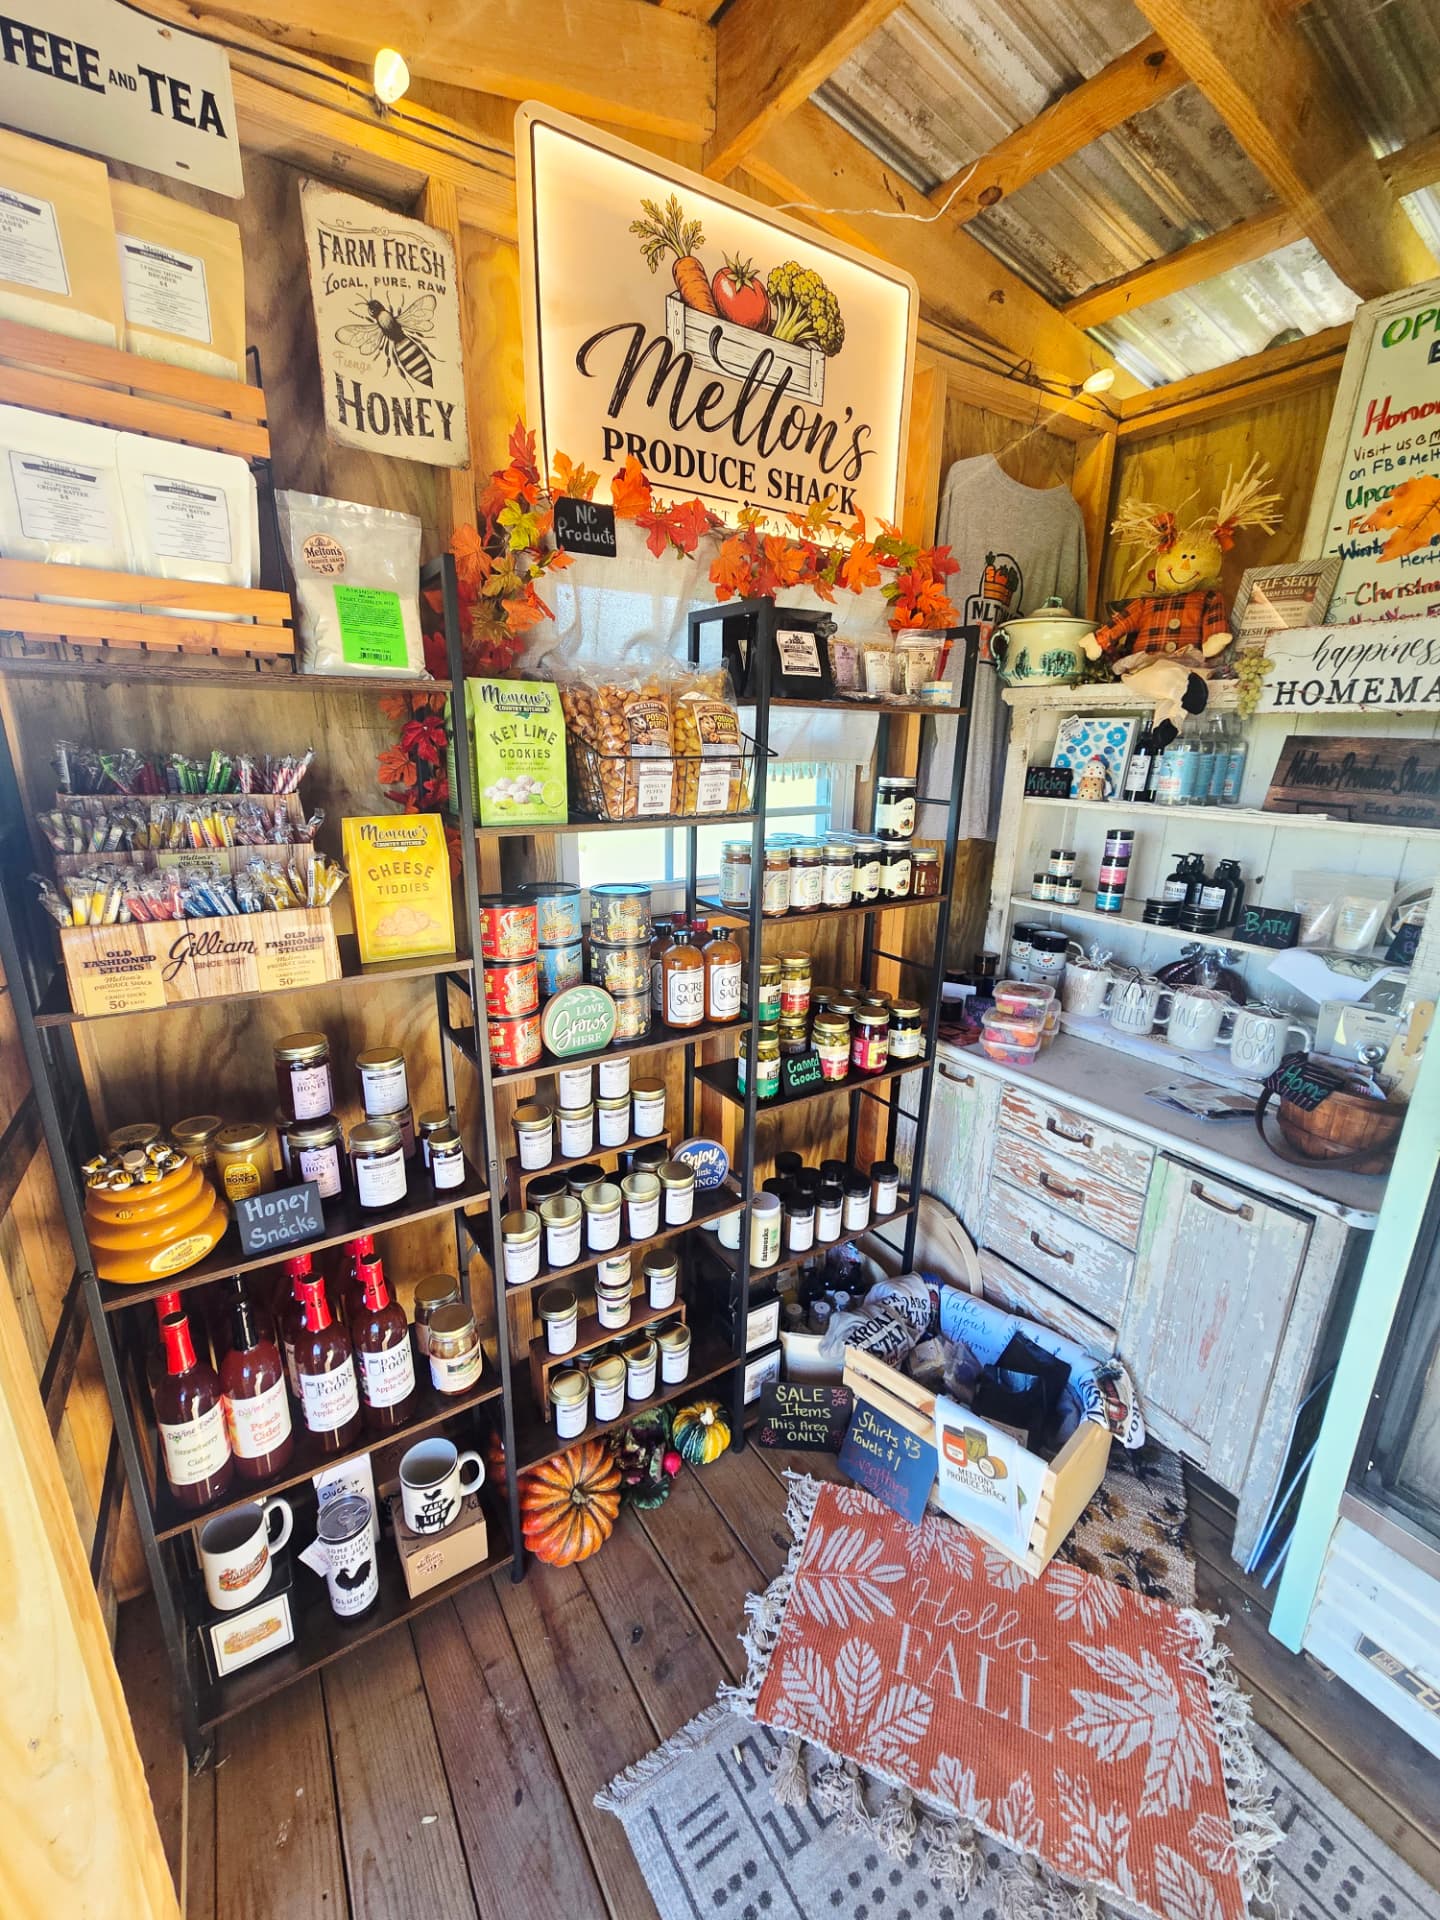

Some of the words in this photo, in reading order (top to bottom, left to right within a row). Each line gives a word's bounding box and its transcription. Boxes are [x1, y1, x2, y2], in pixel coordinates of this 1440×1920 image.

[108, 69, 137, 92] AND
[137, 63, 228, 139] TEA
[318, 228, 377, 270] FARM
[383, 238, 446, 281] FRESH
[417, 280, 447, 295] RAW
[334, 371, 456, 441] HONEY
[575, 322, 878, 483] Melton's
[1354, 446, 1391, 462] Visit
[1397, 438, 1411, 451] us
[602, 427, 757, 493] PRODUCE
[767, 468, 858, 517] SHACK
[1350, 468, 1366, 481] on
[1373, 459, 1394, 474] FB
[576, 505, 597, 525] NC
[558, 516, 615, 546] Products
[303, 546, 342, 558] Melton's
[489, 724, 518, 746] KEY
[524, 723, 558, 746] LIME
[499, 748, 551, 759] COOKIES
[1028, 776, 1067, 790] Kitchen
[368, 862, 434, 881] CHEESE
[377, 882, 430, 895] TIDDIES
[1245, 911, 1291, 935] BATH
[265, 936, 325, 949] FASHIONED
[284, 931, 306, 940] OLD
[83, 955, 157, 968] FASHIONED
[106, 950, 132, 958] OLD
[162, 930, 257, 981] Gilliam
[100, 963, 145, 975] STICKS
[109, 999, 127, 1010] 50
[576, 1003, 605, 1018] LOVE
[552, 1010, 614, 1050] Grows
[572, 1033, 603, 1048] HERE
[296, 1081, 326, 1093] HONEY
[789, 1068, 822, 1087] Goods
[1279, 1063, 1328, 1101] Home
[305, 1160, 336, 1173] HONEY
[680, 1147, 720, 1170] Enjoy
[244, 1190, 309, 1222] Honey
[249, 1216, 318, 1249] Snacks
[776, 1385, 825, 1403] SALE
[781, 1402, 832, 1419] Items
[250, 1412, 281, 1432] Peach
[253, 1422, 281, 1442] Cider
[768, 1417, 795, 1431] This
[800, 1421, 829, 1433] Area
[787, 1431, 827, 1444] ONLY
[858, 1411, 900, 1449] Shirts
[903, 1435, 921, 1460] $3
[852, 1428, 883, 1458] Towels
[886, 1450, 902, 1472] $1
[910, 1577, 1049, 1664] Hello
[891, 1621, 1054, 1743] FALL
